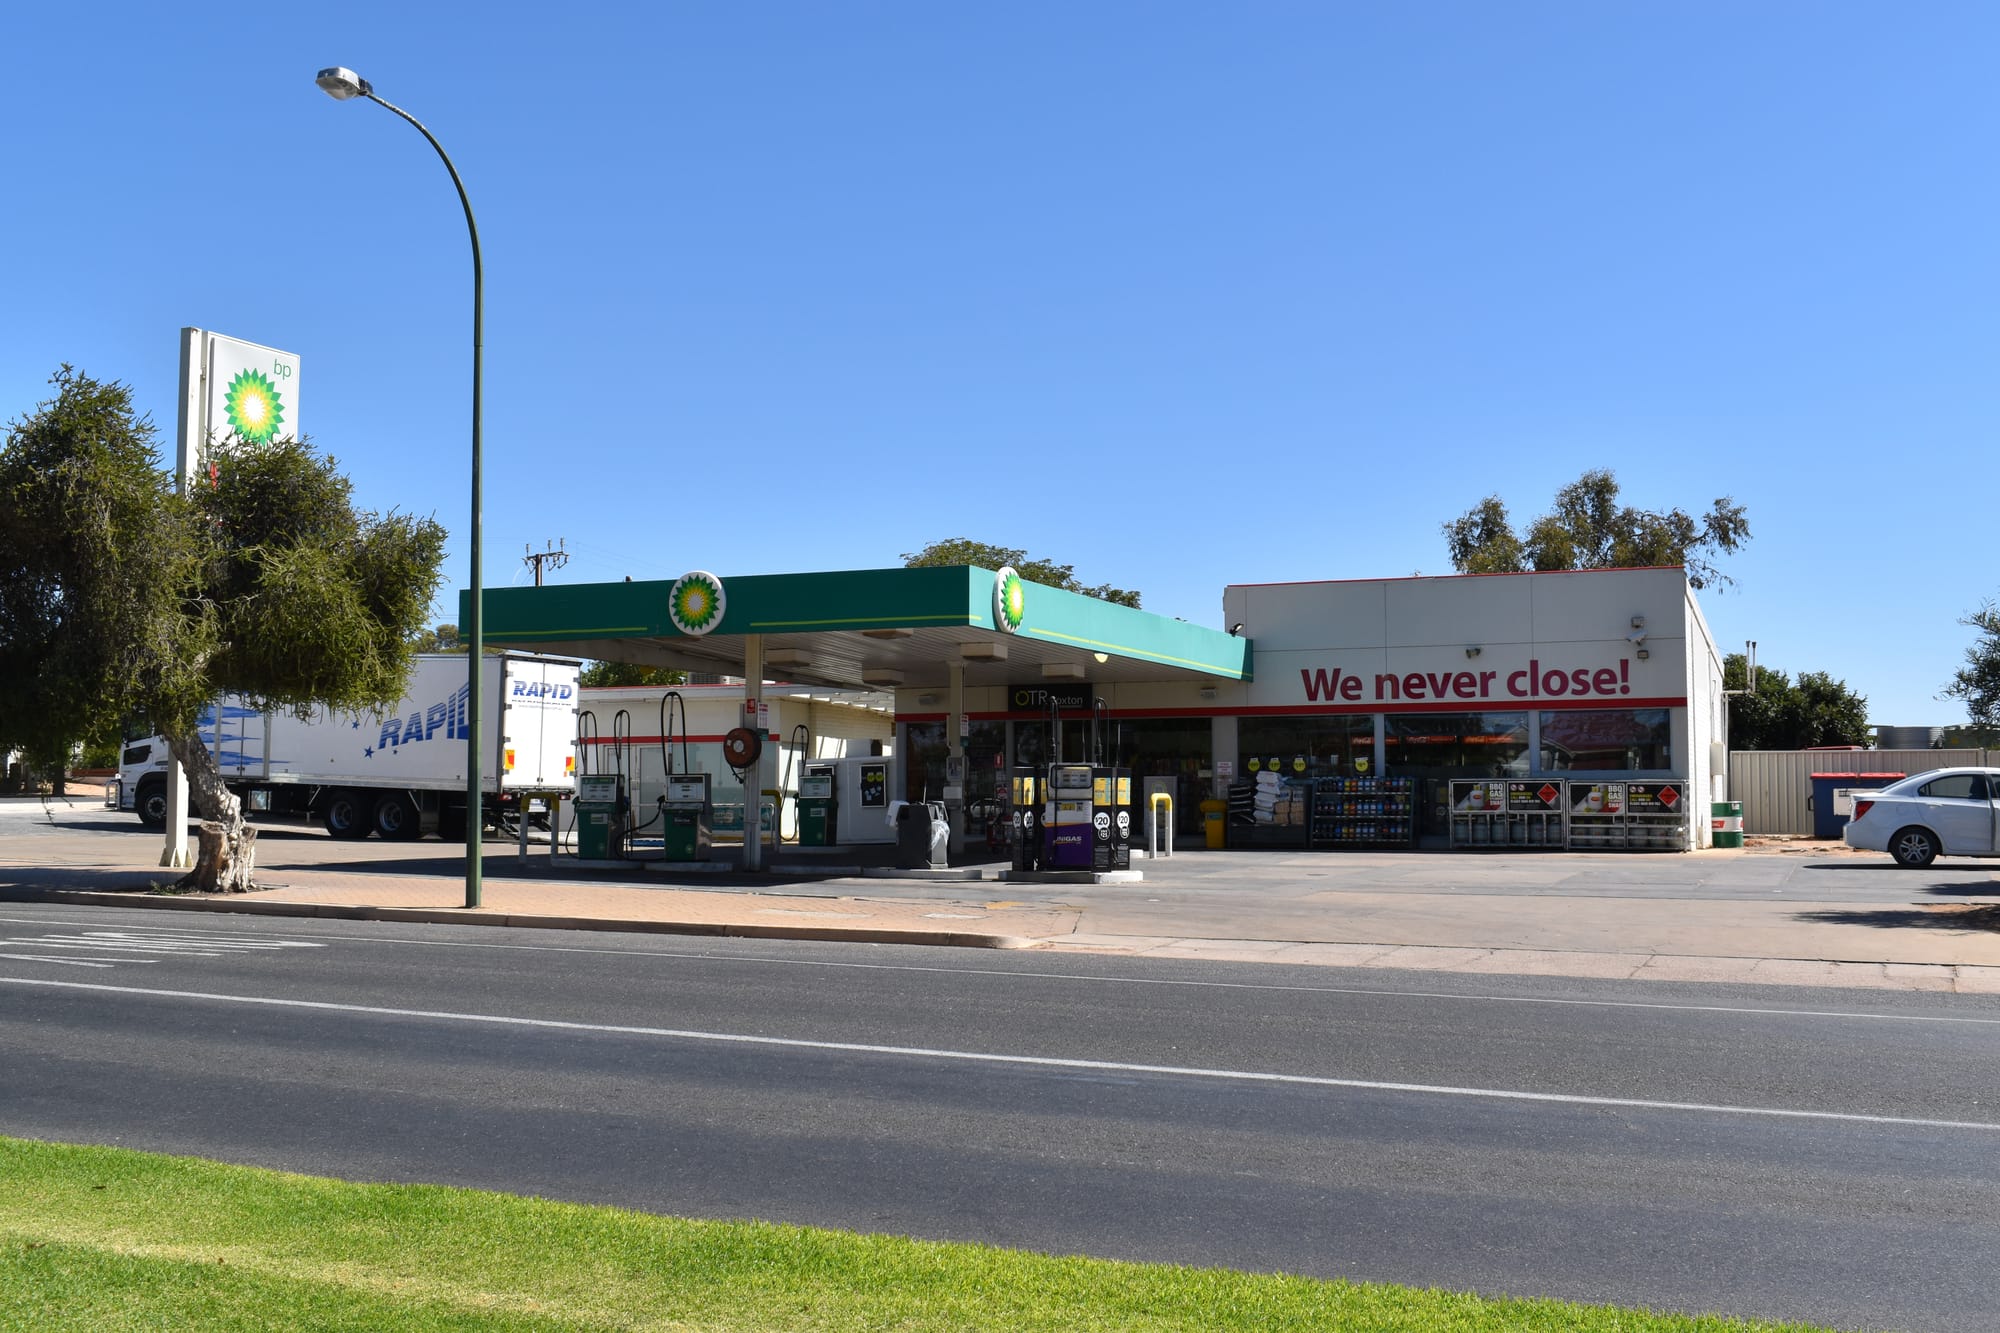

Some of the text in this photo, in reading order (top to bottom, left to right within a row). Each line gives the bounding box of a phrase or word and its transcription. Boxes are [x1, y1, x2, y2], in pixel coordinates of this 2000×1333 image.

[273, 358, 292, 380] bp
[1300, 658, 1631, 701] We never close!
[512, 680, 573, 700] RAPID
[1015, 689, 1083, 706] OTR oxton
[1608, 792, 1622, 800] GAS
